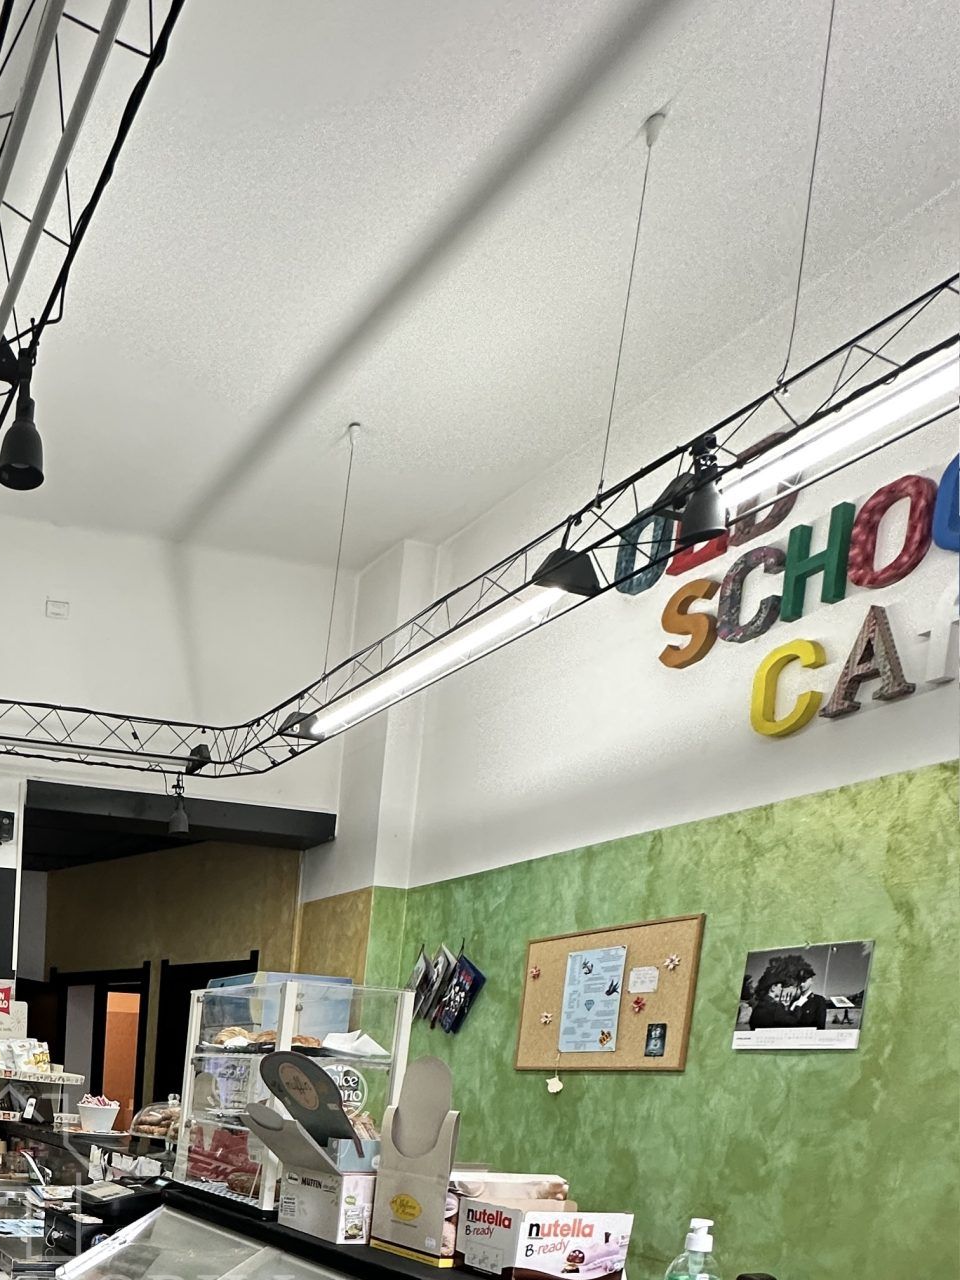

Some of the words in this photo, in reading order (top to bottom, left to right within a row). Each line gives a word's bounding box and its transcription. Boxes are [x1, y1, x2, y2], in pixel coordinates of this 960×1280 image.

[301, 1176, 322, 1189] MUFFIN
[467, 1208, 512, 1230] nutella
[528, 1218, 595, 1239] nutella
